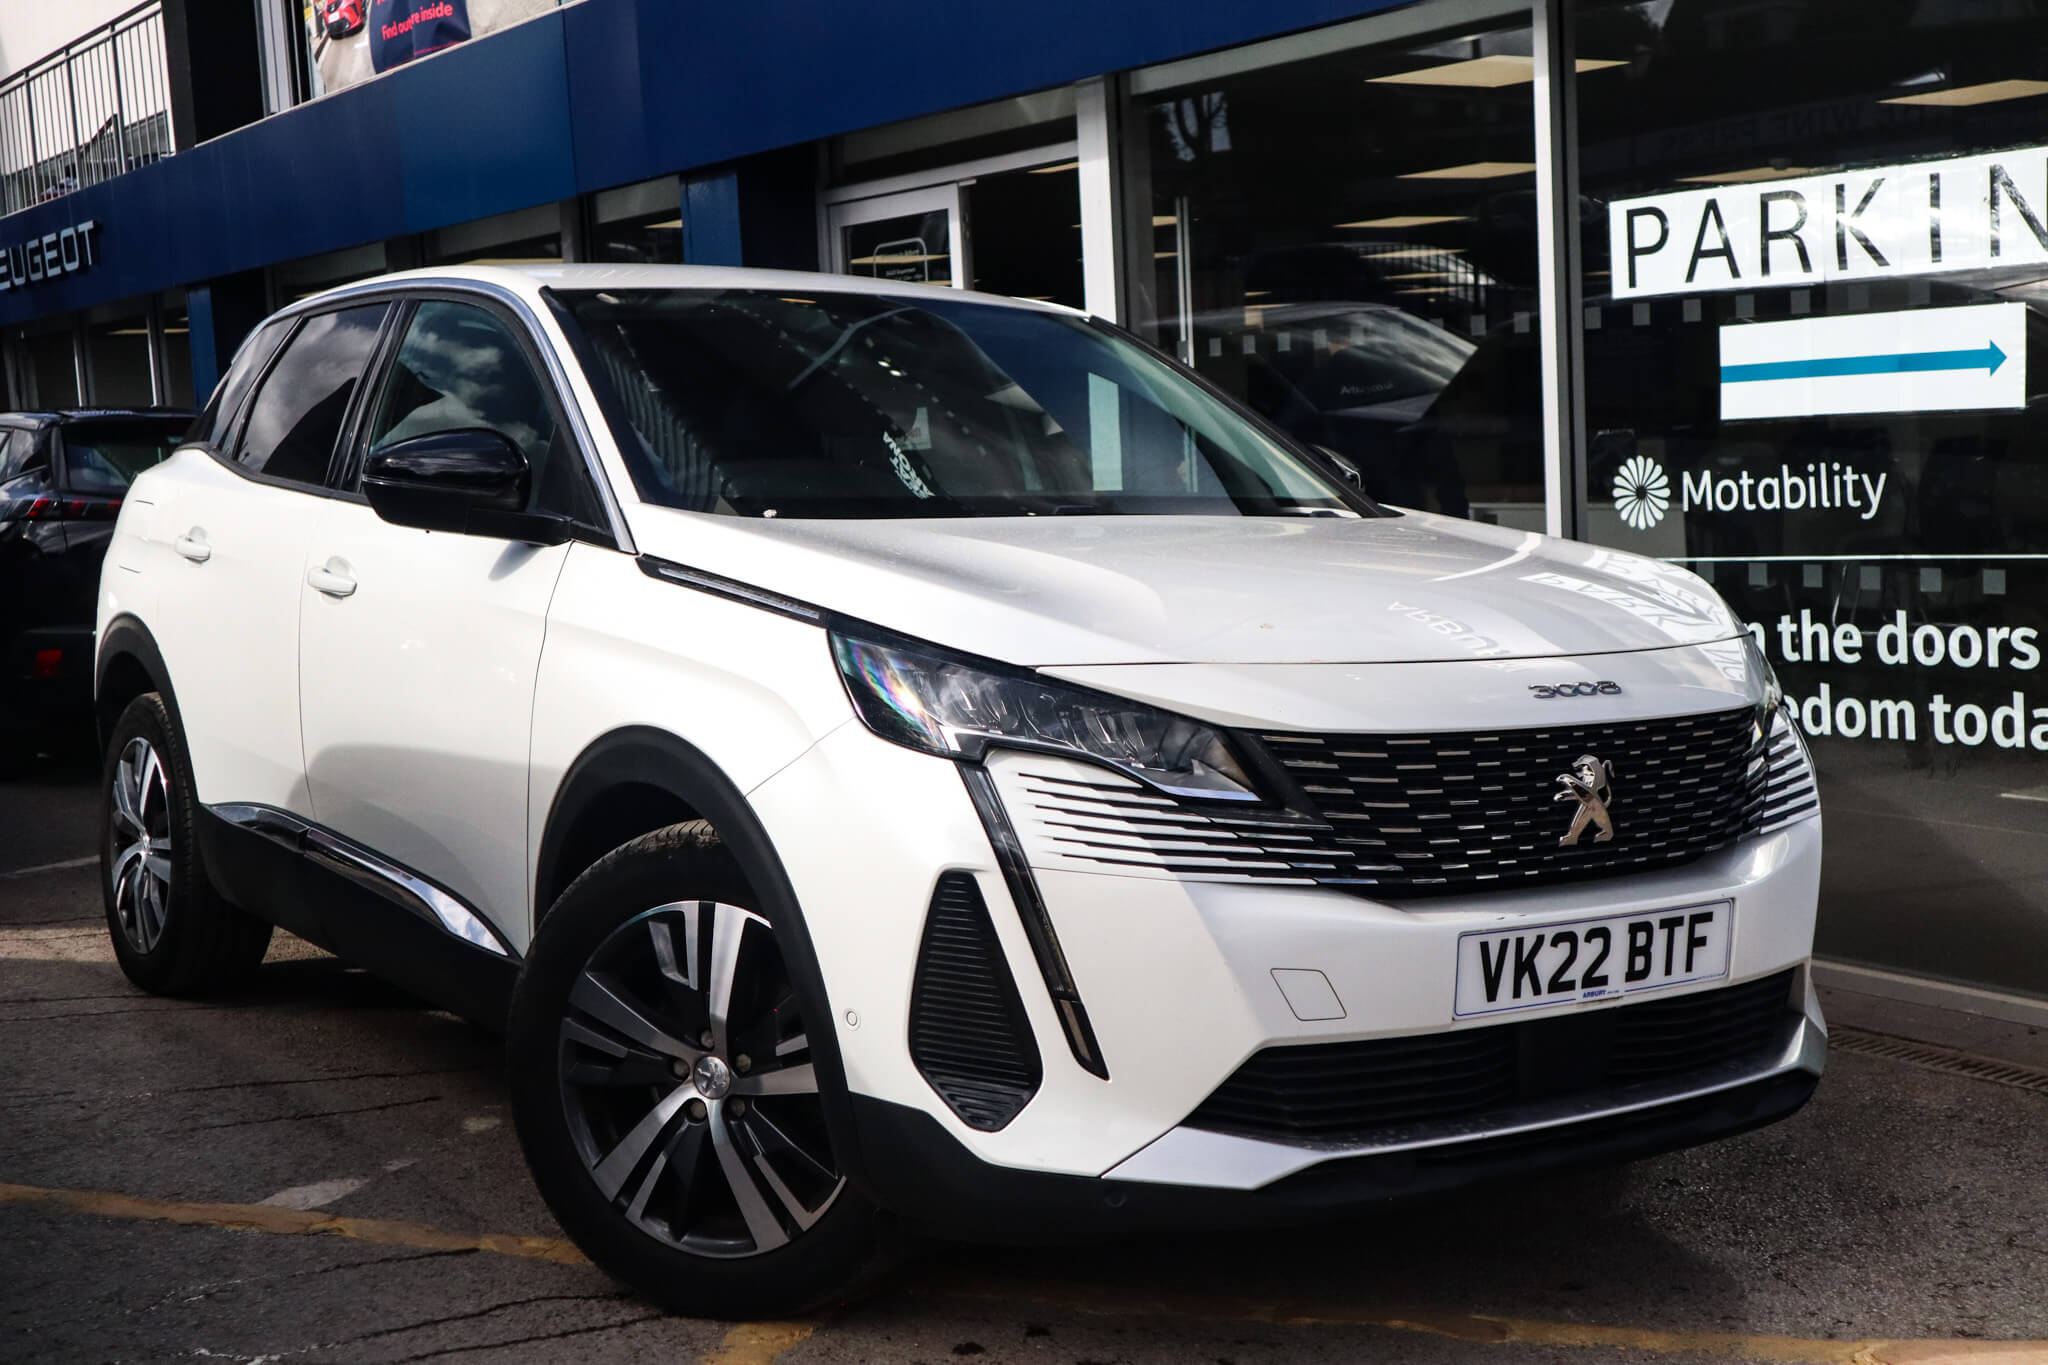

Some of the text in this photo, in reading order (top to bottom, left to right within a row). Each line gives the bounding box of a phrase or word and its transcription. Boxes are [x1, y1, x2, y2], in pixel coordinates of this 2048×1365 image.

[381, 20, 398, 40] Find
[420, 1, 453, 22] inside
[1626, 163, 2048, 288] PARKIN
[1683, 462, 1887, 520] Motability
[1777, 608, 1863, 664] the
[1876, 609, 2041, 670] doors
[1528, 680, 1622, 699] 3008
[1479, 911, 1714, 1003] VK22 BTF
[1582, 989, 1607, 999] ARBURY
